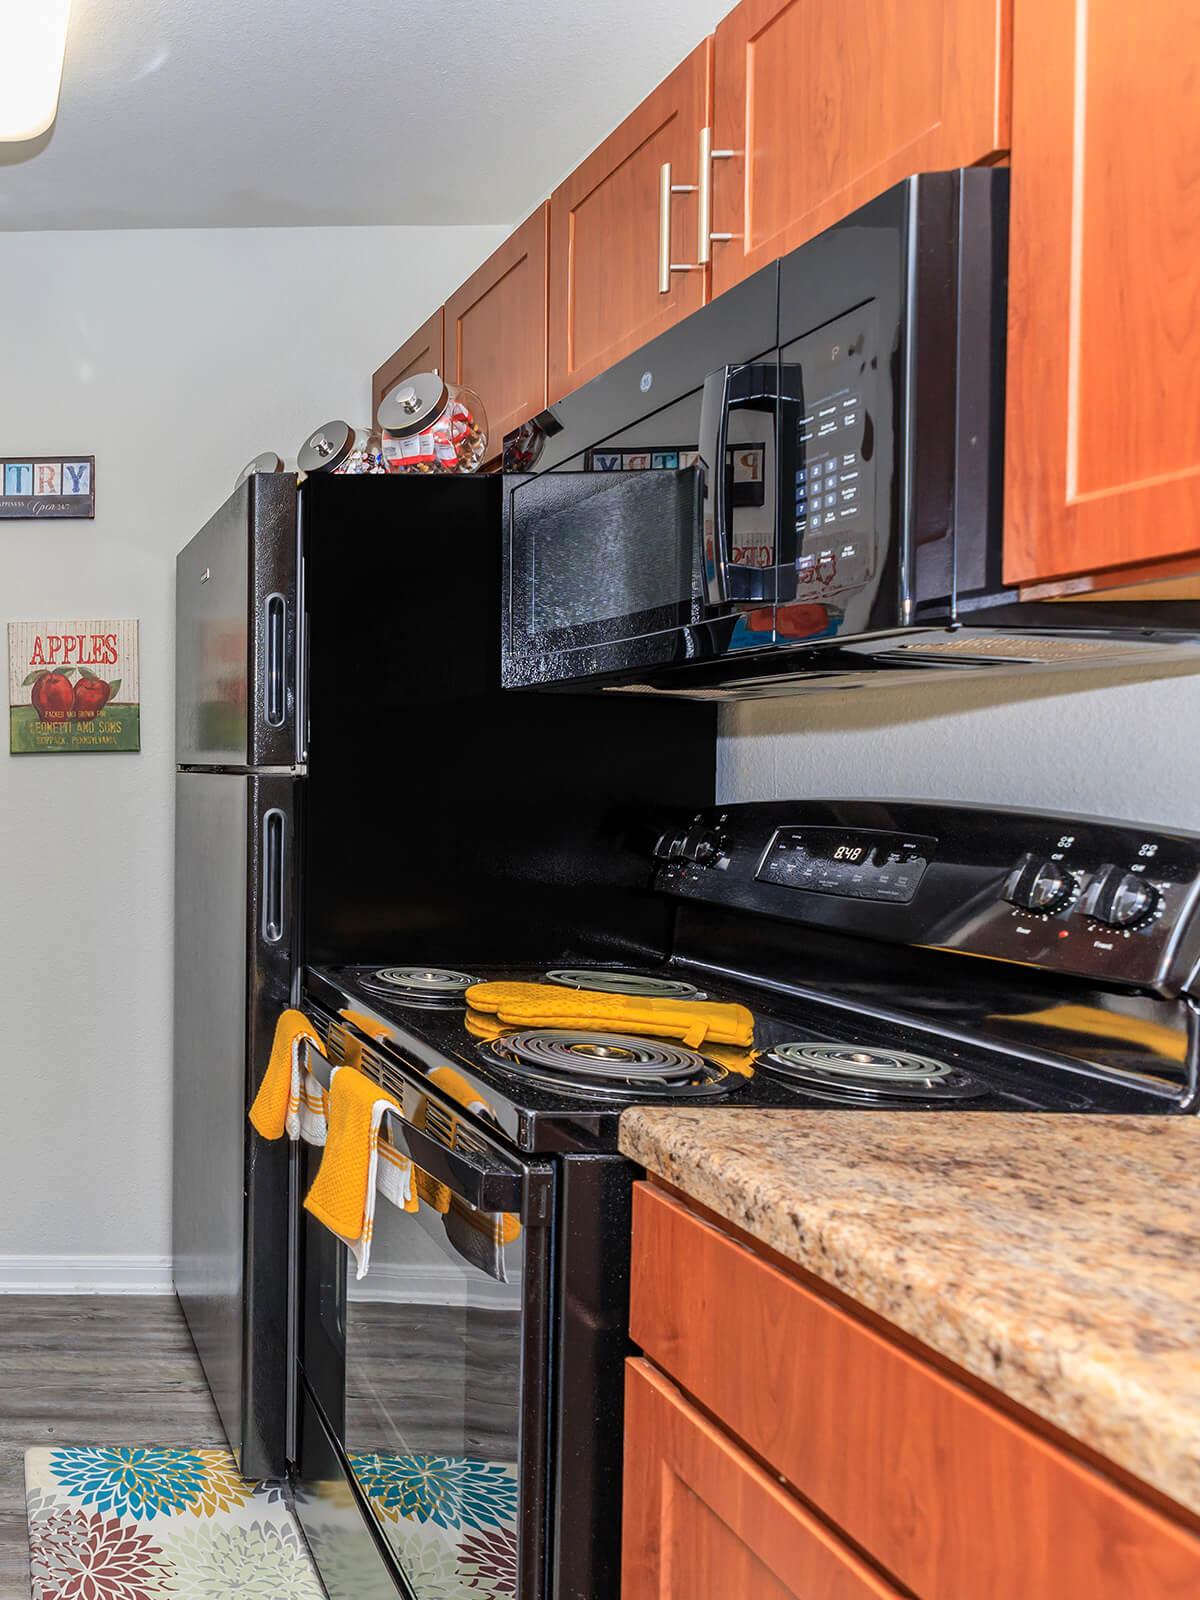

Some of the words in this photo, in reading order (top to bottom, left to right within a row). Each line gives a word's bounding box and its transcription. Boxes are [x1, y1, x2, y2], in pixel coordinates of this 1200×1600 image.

[29, 634, 118, 665] APPLES
[76, 720, 95, 733] AND
[99, 720, 122, 733] SONS
[833, 846, 862, 861] 8:48
